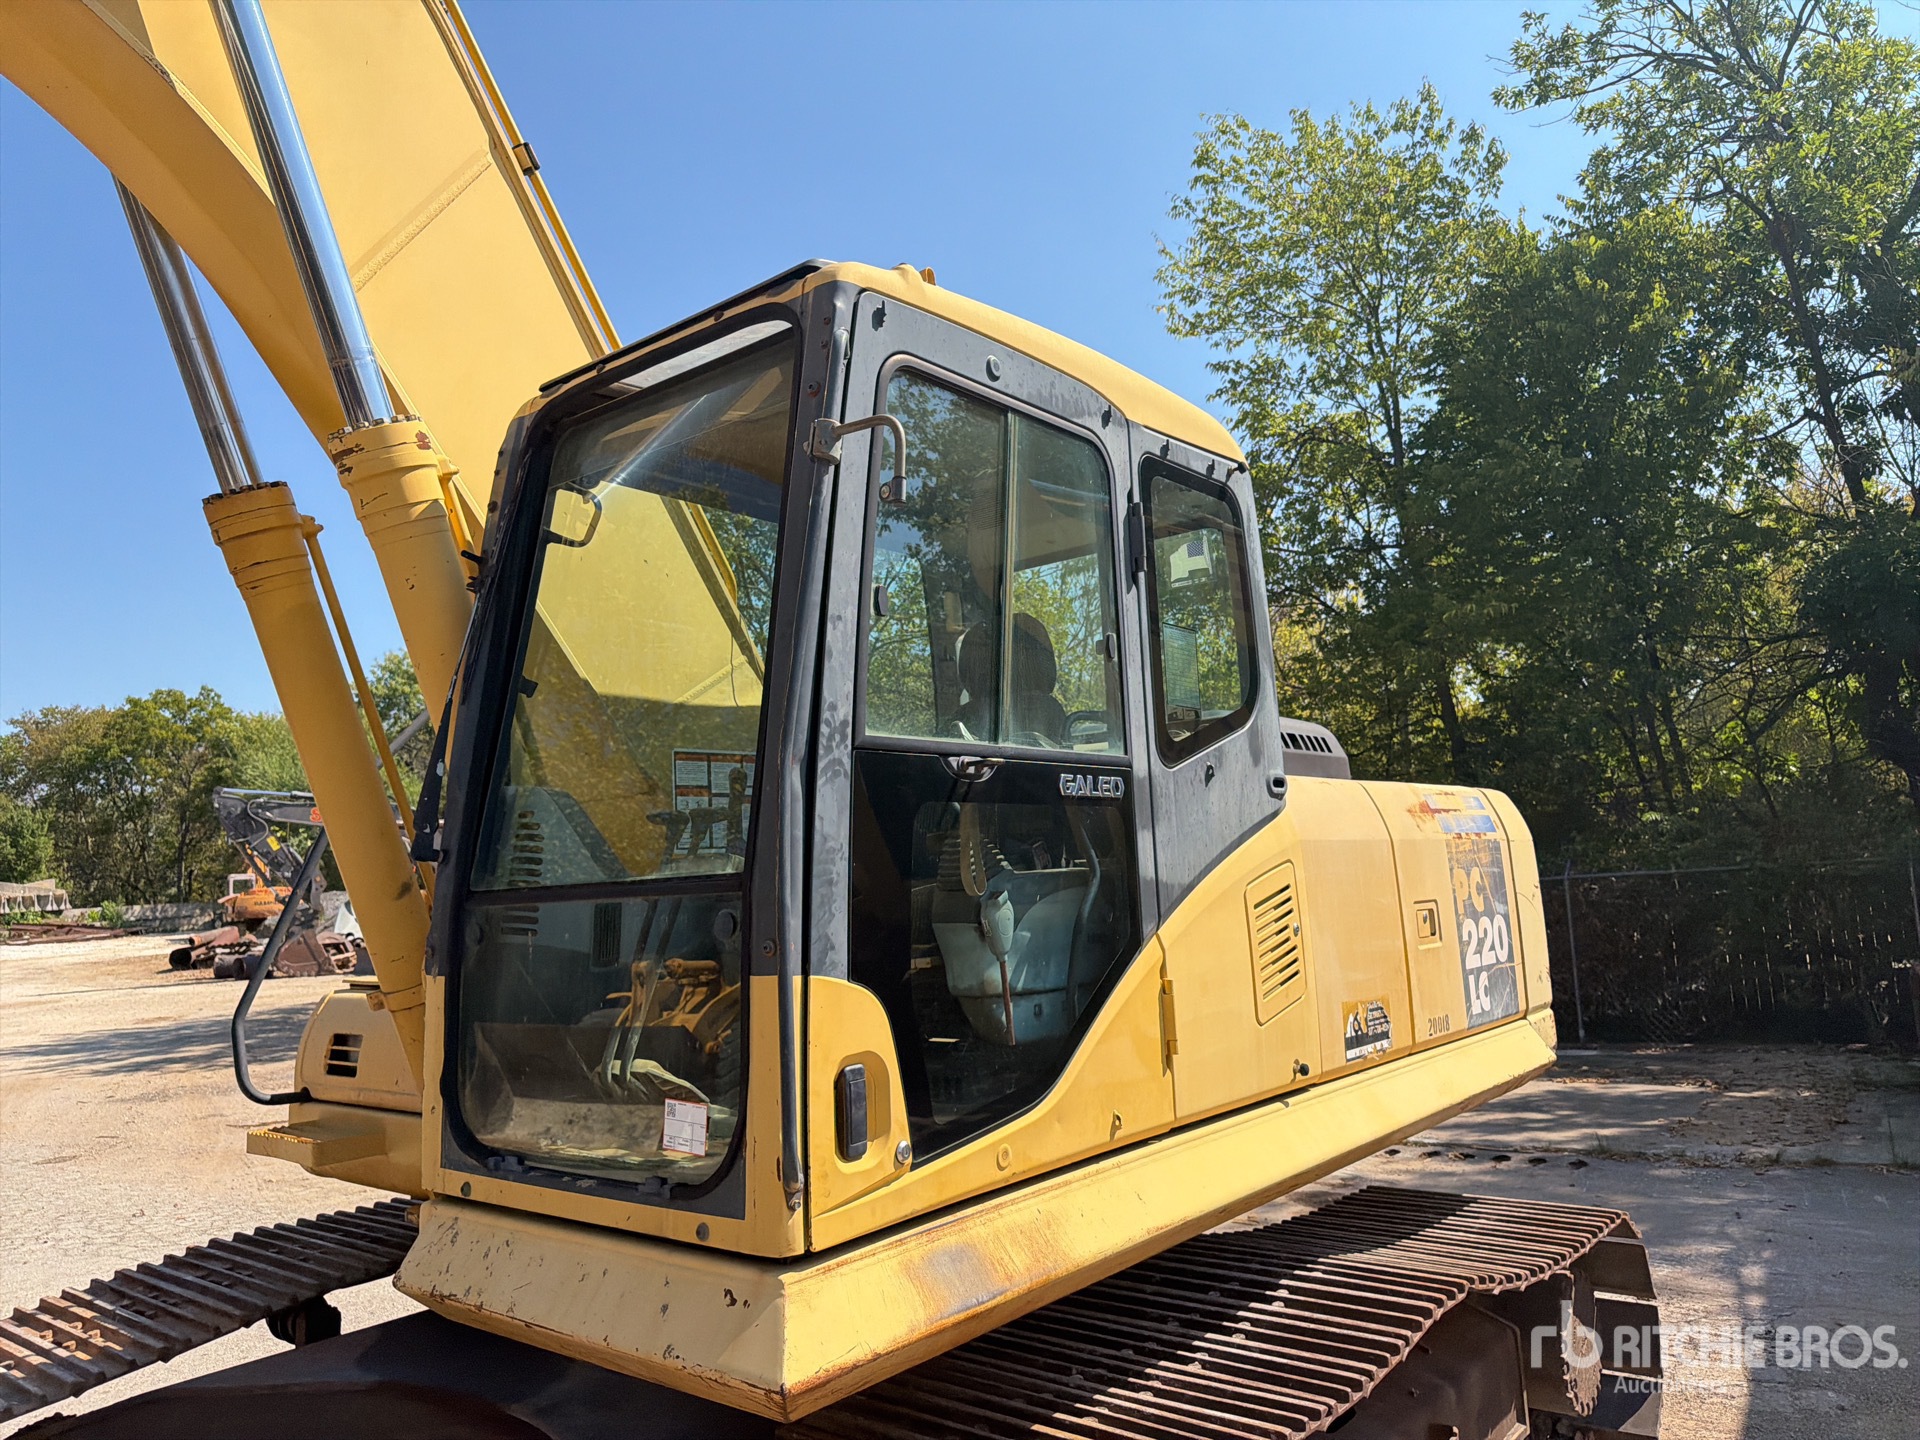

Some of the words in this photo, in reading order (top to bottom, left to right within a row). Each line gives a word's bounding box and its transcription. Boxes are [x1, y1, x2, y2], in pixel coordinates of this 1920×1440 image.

[1060, 773, 1125, 798] GALEO
[1454, 866, 1485, 914] PC
[1462, 914, 1509, 970] 220
[1468, 971, 1491, 1015] LC
[1427, 1014, 1450, 1037] 20018
